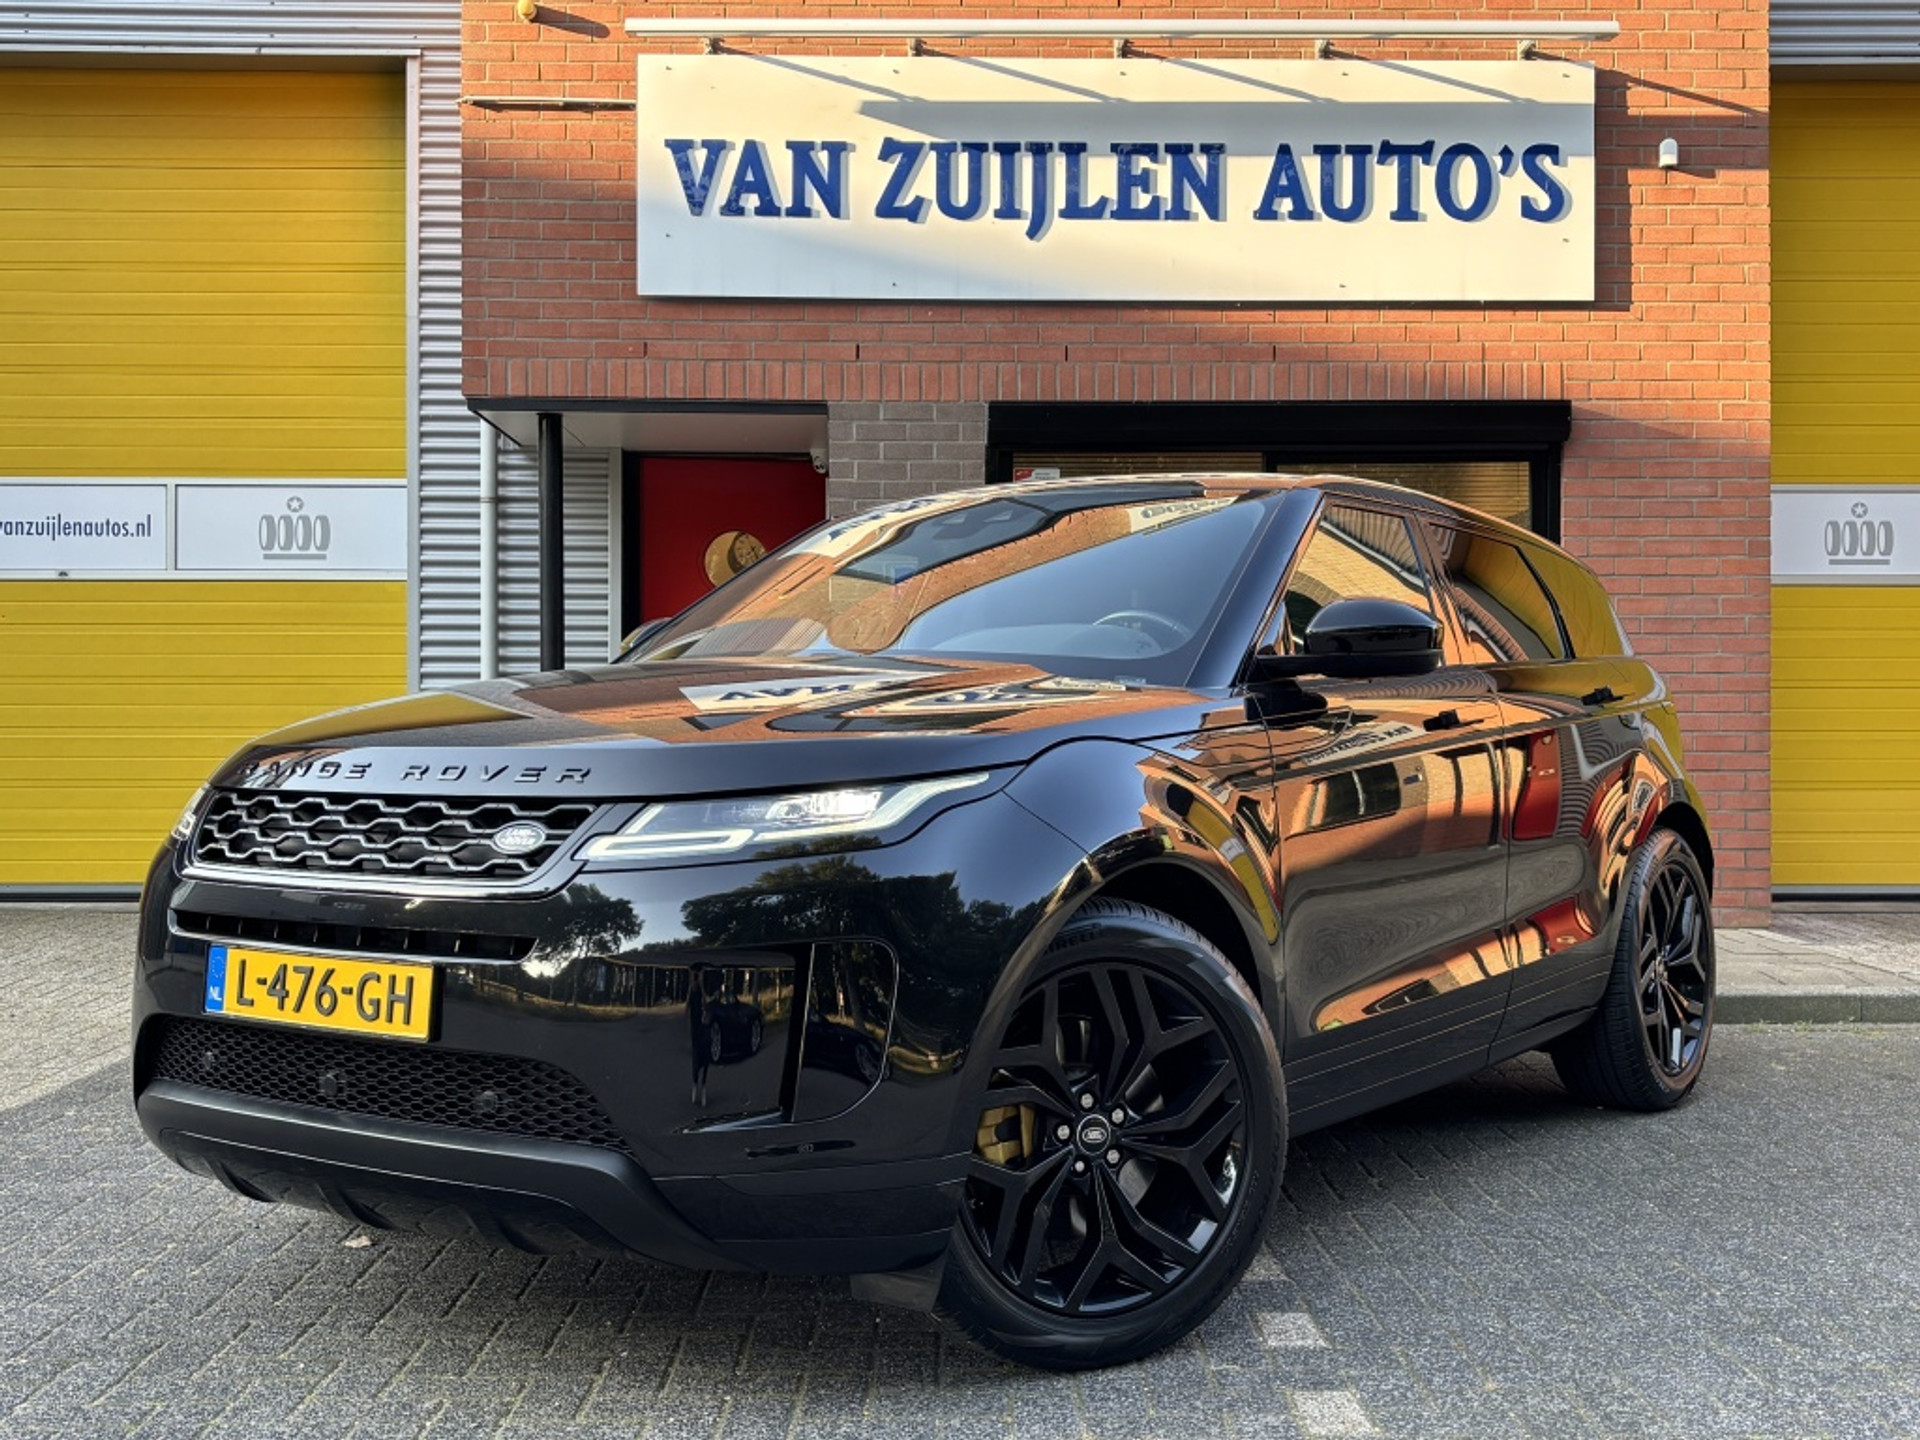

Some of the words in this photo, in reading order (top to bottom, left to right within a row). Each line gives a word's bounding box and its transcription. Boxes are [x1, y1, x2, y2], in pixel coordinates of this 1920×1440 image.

[664, 138, 853, 220] VAN
[875, 137, 1229, 241] ZUIJLEN
[1253, 139, 1571, 223] AUTO'S
[239, 761, 372, 779] RANGE
[401, 765, 591, 783] ROVER
[209, 985, 222, 1001] NL
[236, 958, 414, 1025] L-476-GH
